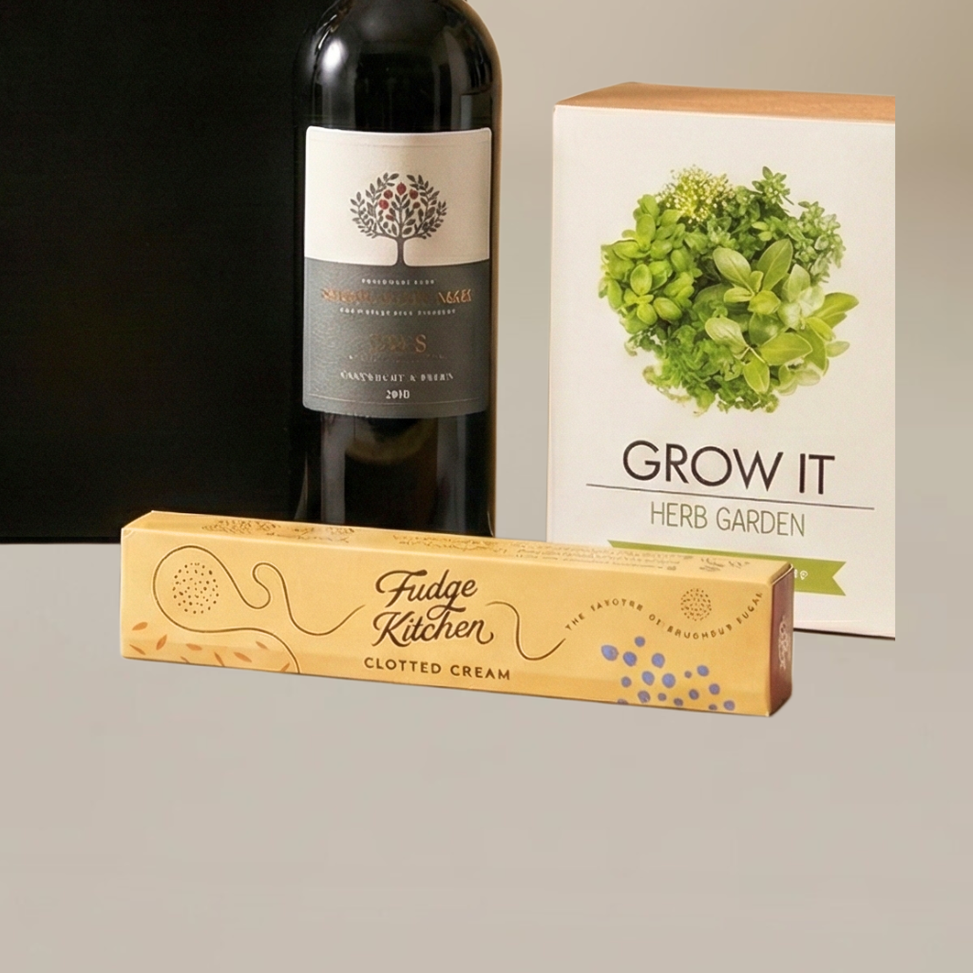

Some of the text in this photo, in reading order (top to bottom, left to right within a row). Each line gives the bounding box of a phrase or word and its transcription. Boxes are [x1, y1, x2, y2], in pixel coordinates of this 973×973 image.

[622, 439, 836, 495] GROW IT
[650, 501, 806, 538] HERB GARDEN
[375, 568, 478, 621] Fudge
[371, 610, 495, 648] Kitchen
[364, 656, 511, 681] CLOTTED CREAM
